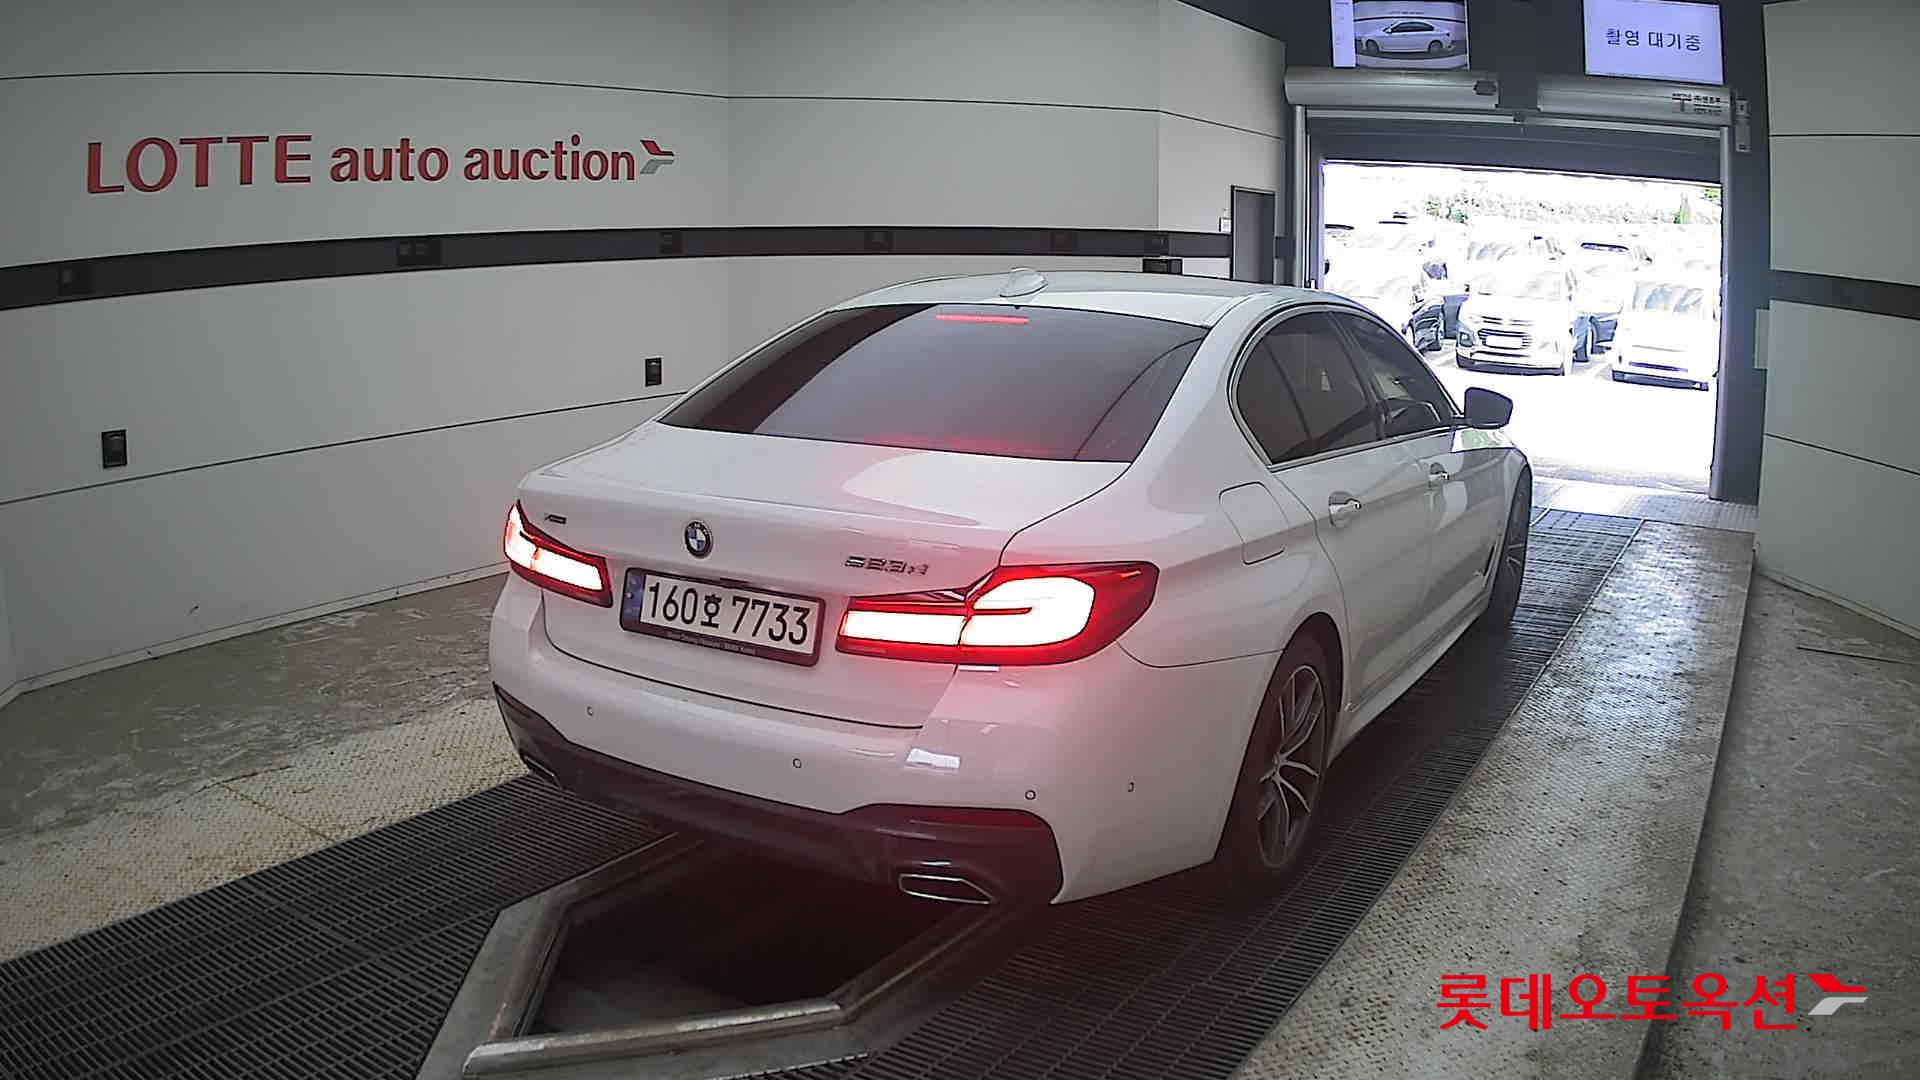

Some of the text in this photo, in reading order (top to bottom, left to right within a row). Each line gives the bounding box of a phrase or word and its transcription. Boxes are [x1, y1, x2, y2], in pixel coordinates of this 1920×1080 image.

[1648, 31, 1701, 52] 대기중
[86, 133, 637, 194] LOTTE auto auction
[732, 595, 811, 645] 7733
